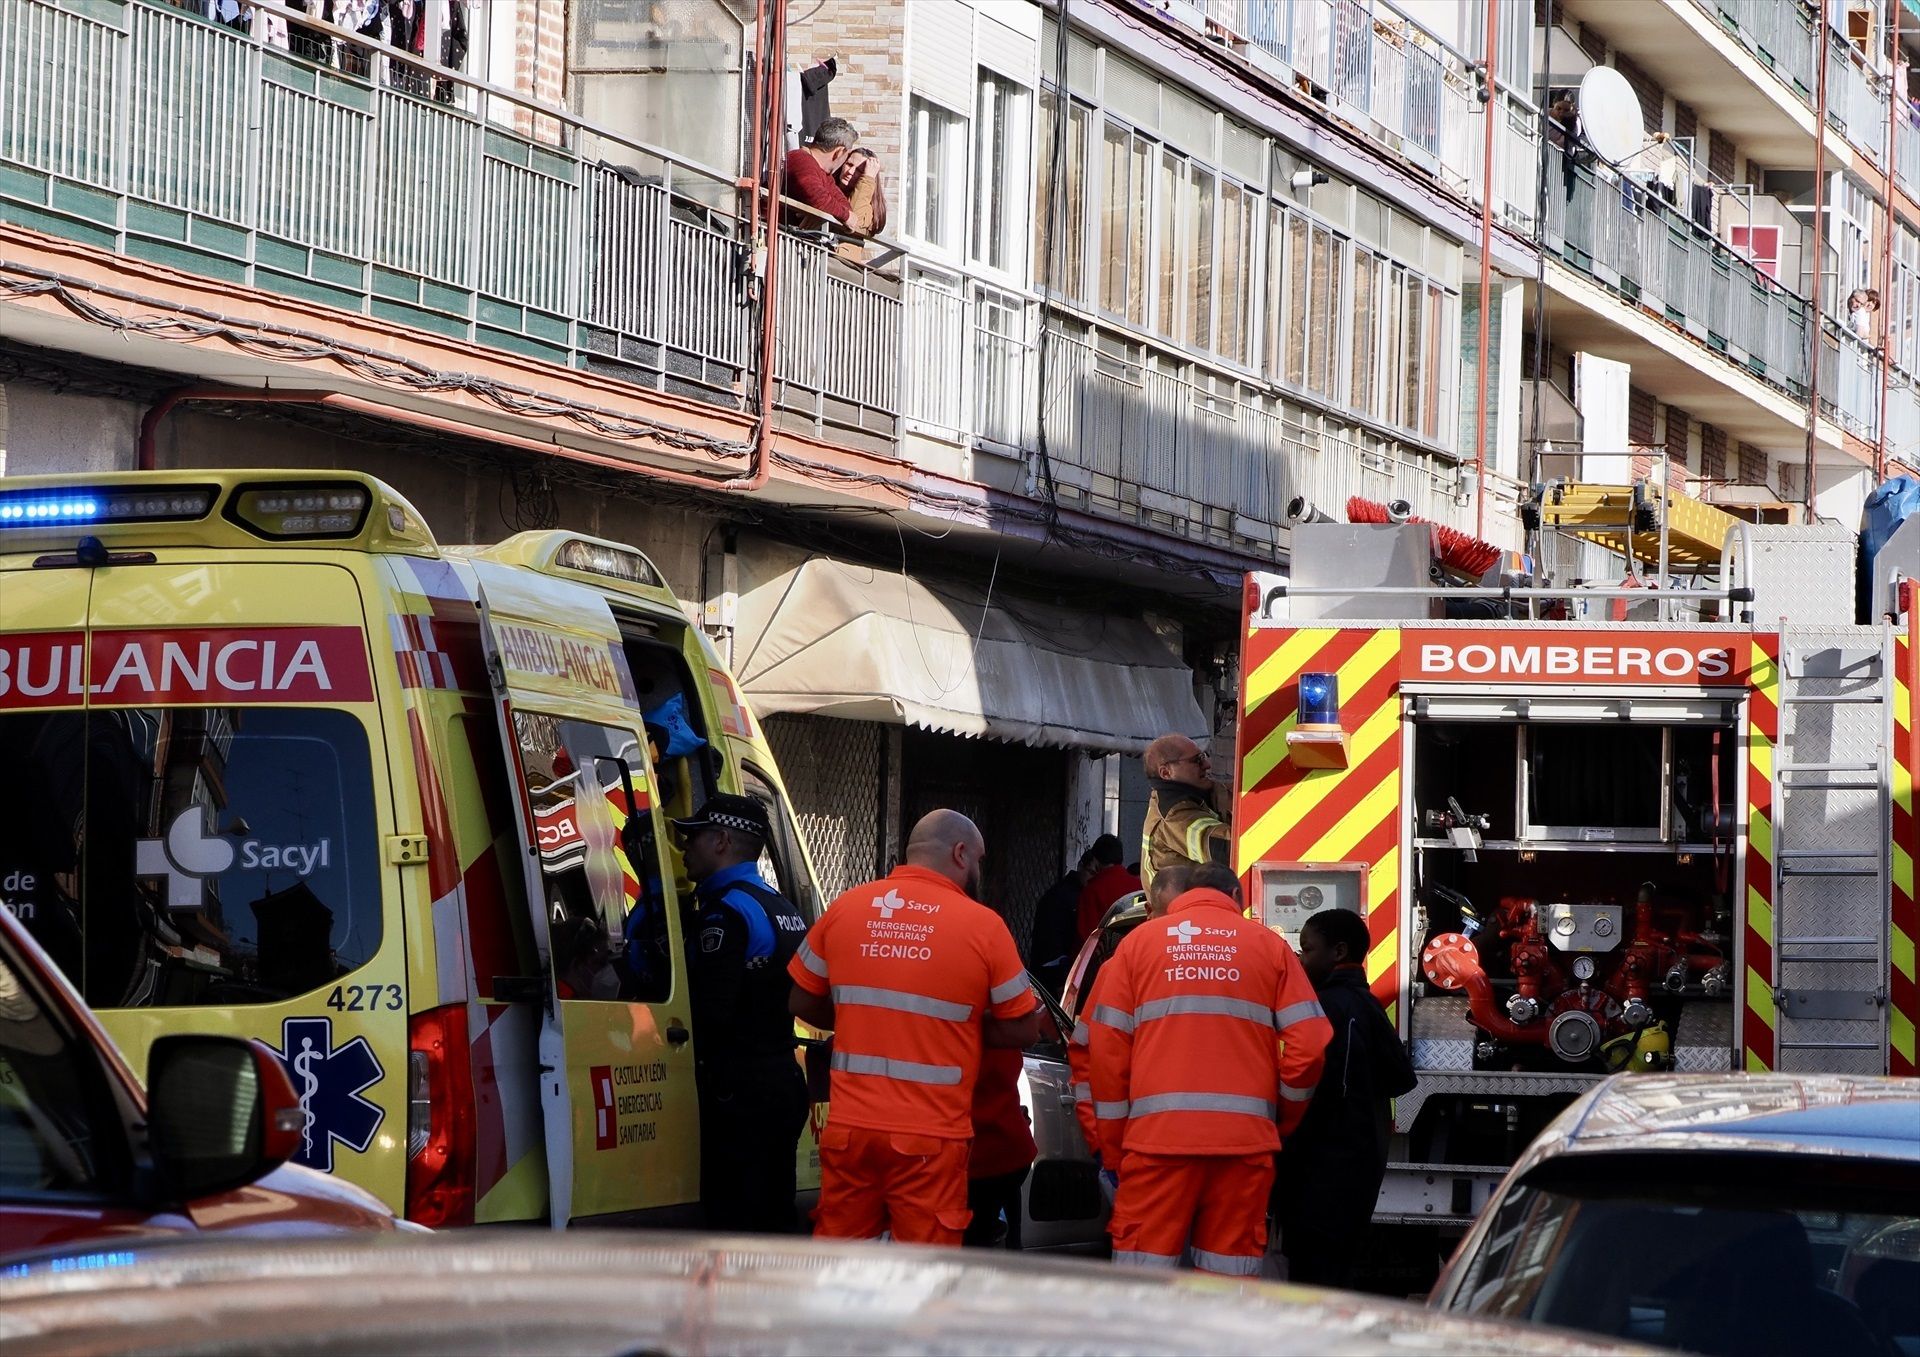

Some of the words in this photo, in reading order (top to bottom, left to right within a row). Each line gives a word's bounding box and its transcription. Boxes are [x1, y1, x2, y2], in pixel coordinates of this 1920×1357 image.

[500, 625, 617, 693] AMBULANCIA
[1421, 645, 1729, 676] BOMBEROS
[242, 840, 329, 874] Sacyl
[3, 870, 35, 892] de
[906, 900, 941, 914] Sacyl
[866, 920, 935, 934] EMERGENCIAS
[870, 930, 927, 942] SANITARIAS
[1204, 927, 1237, 938] Sacyl
[859, 941, 932, 961] TÉCNICO
[1166, 944, 1238, 954] EMERGENCIAS
[1172, 953, 1232, 962] SANITARIAS
[1164, 964, 1240, 982] TÉCNICO
[326, 985, 403, 1011] 4273
[614, 1066, 643, 1085] CASTILLA
[649, 1059, 666, 1081] LEÓN
[618, 1093, 662, 1115] EMERGENCIAS
[620, 1123, 656, 1144] SANITARIAS
